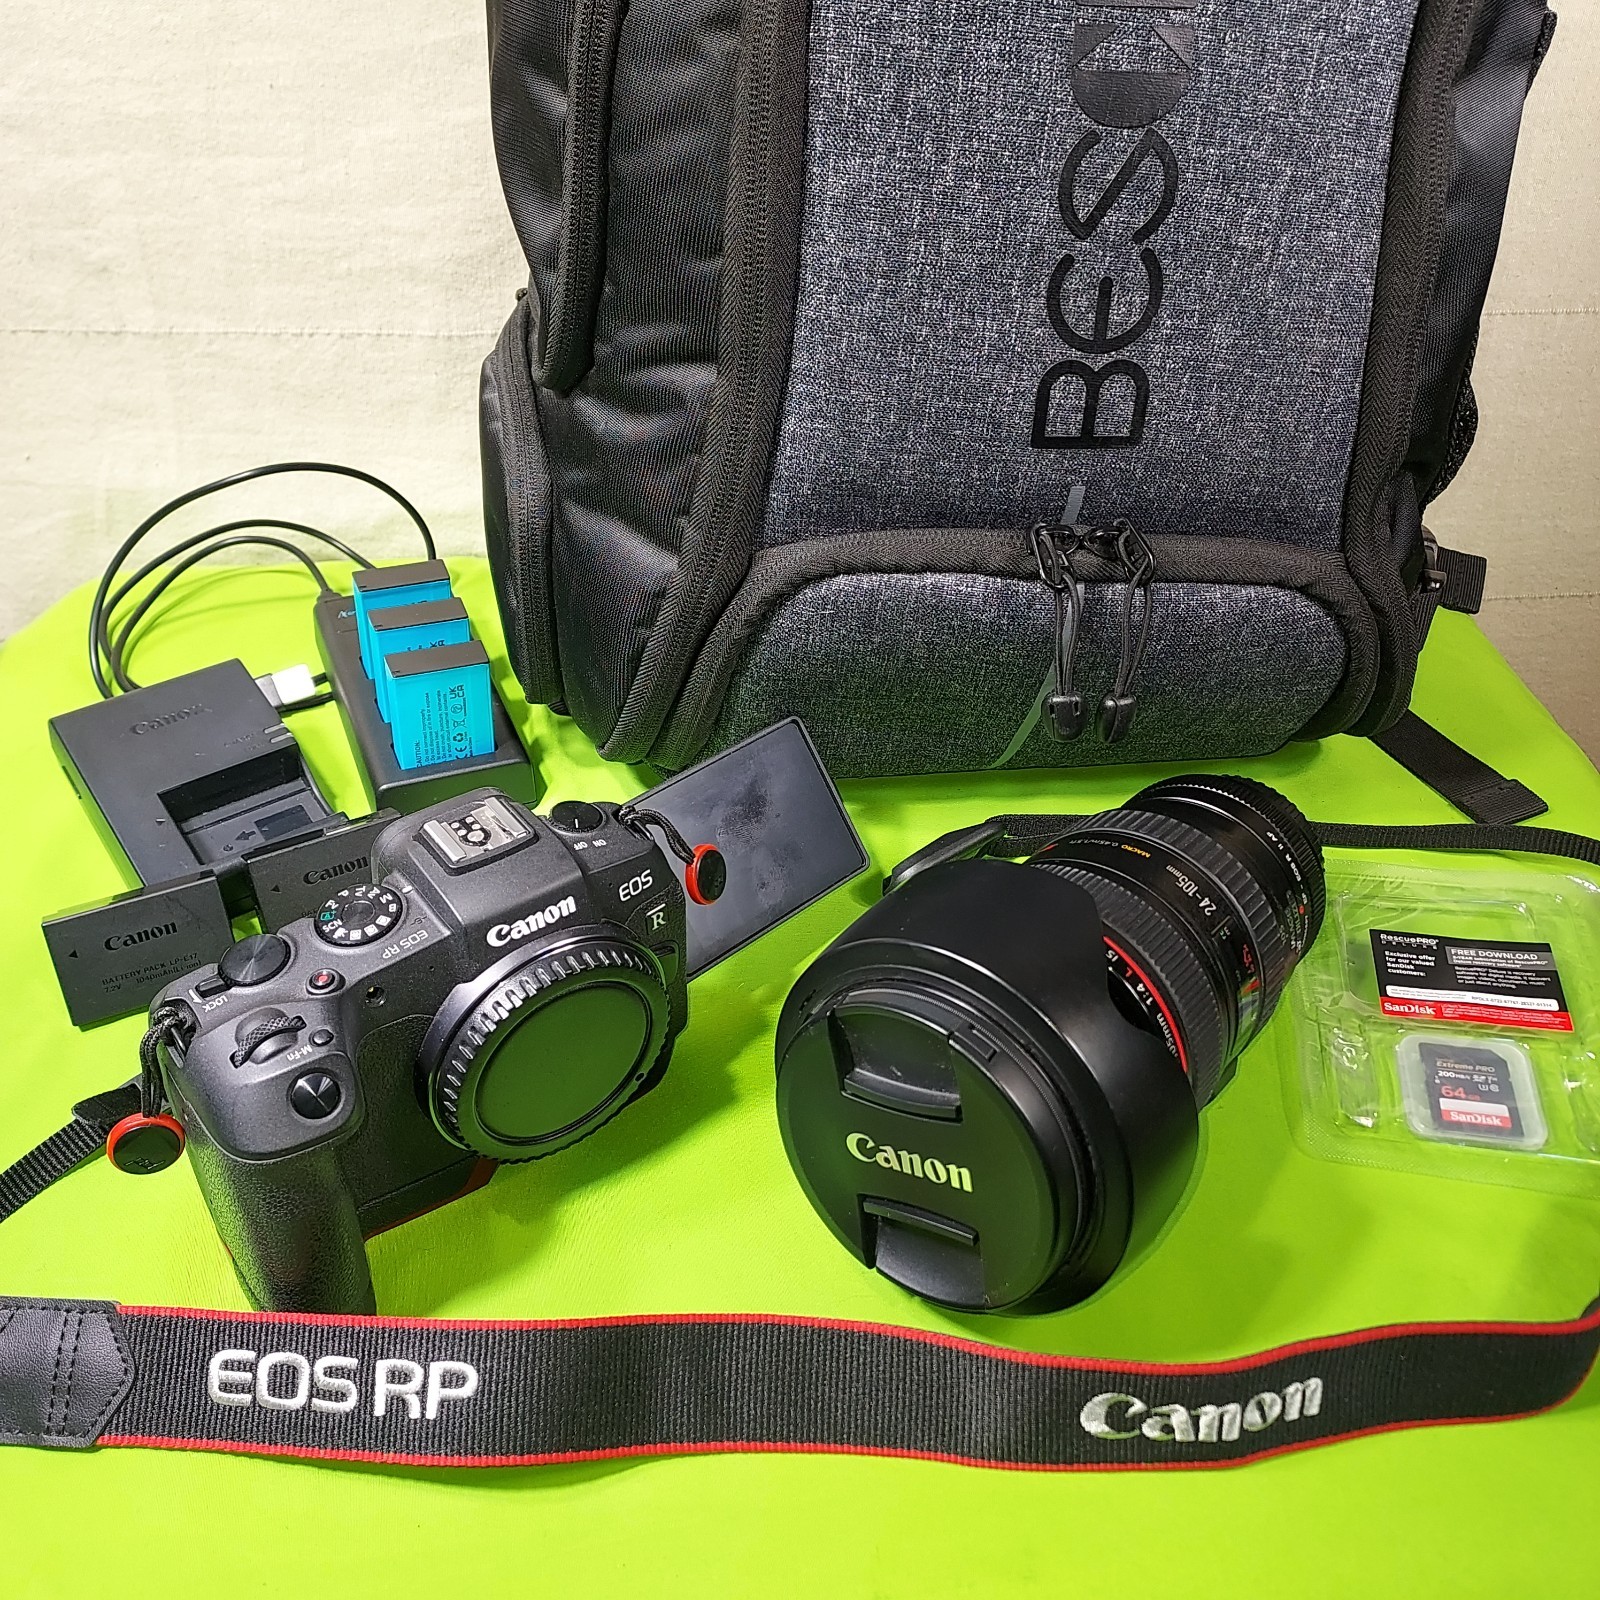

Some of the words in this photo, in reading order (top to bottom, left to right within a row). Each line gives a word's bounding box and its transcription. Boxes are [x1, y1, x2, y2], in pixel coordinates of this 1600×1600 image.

[449, 686, 458, 700] UK
[457, 685, 465, 698] CA
[593, 839, 607, 848] ON
[1121, 844, 1151, 858] MACRO
[303, 856, 369, 885] Canon
[618, 869, 653, 902] EOS
[322, 919, 343, 933] SCN
[486, 895, 577, 947] Canon
[104, 921, 178, 951] Canon
[400, 929, 429, 950] EOS
[382, 944, 400, 959] RP
[1105, 949, 1119, 962] IS
[1385, 950, 1417, 959] Exclusive
[1451, 948, 1476, 956] FREE
[1478, 950, 1538, 960] DOWNLOAD
[102, 969, 141, 986] BATTERY
[144, 962, 167, 974] PACK
[169, 952, 198, 966] LP-E17
[1386, 962, 1415, 970] SanDisk
[1411, 959, 1435, 967] valued
[104, 983, 122, 993] 7.2V
[201, 995, 228, 1013] LOCK
[1383, 1002, 1437, 1015] SanDisk
[1156, 1012, 1179, 1058] 05mm
[286, 1044, 313, 1061] M-Fn
[1436, 1060, 1474, 1071] Extreme
[1475, 1065, 1495, 1073] PRO
[1441, 1085, 1467, 1099] 64
[1449, 1111, 1502, 1126] SanDisk
[845, 1132, 974, 1193] Canon
[208, 1349, 359, 1414] EOS
[373, 1358, 479, 1420] RP
[1079, 1376, 1323, 1443] Canon
